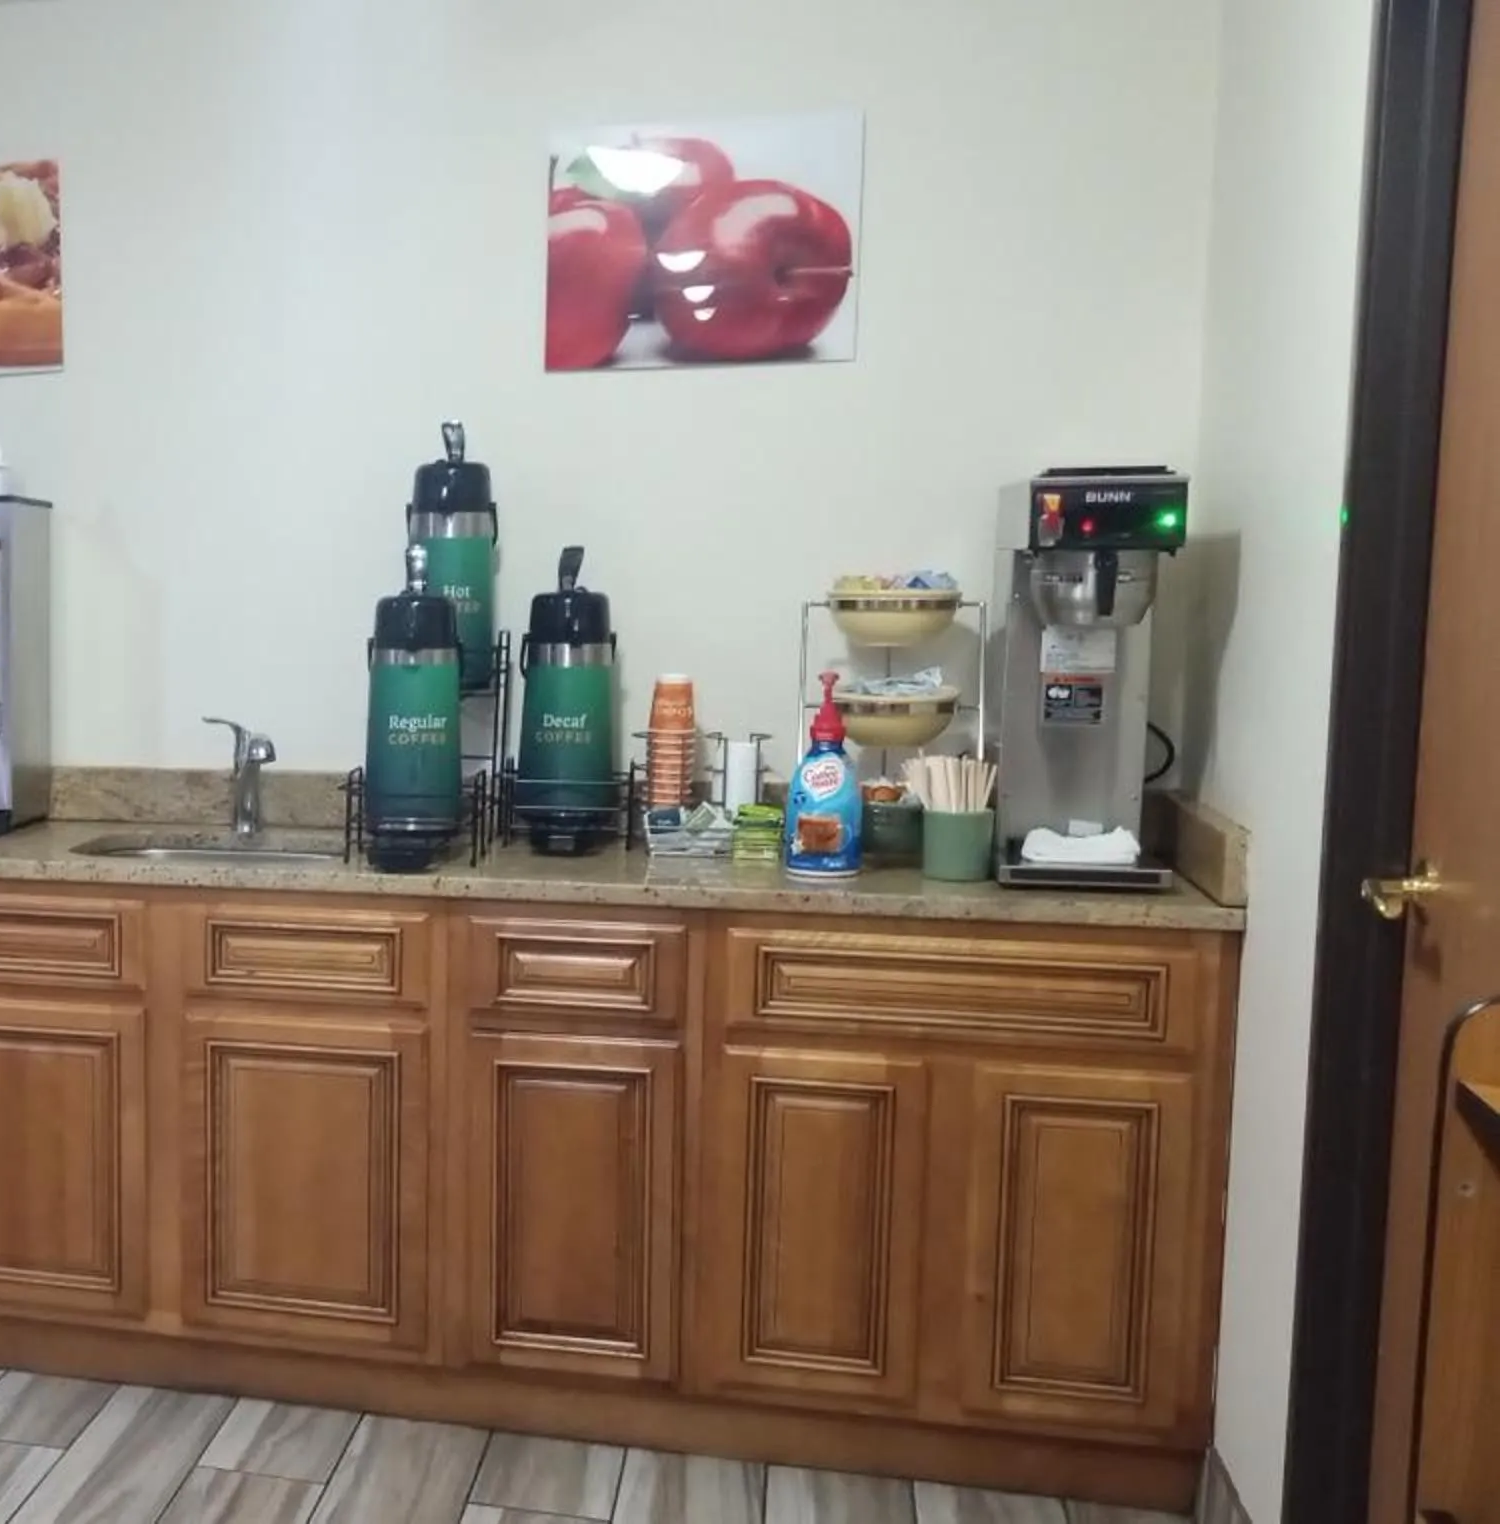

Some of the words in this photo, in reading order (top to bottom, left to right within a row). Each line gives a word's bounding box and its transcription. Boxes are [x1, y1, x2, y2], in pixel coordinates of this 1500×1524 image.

[1085, 491, 1132, 503] BUNN
[443, 584, 470, 598] Hot
[389, 714, 447, 733] Regular
[543, 713, 587, 729] Decaf
[388, 733, 446, 745] COFFEE
[535, 731, 591, 744] COFFEE
